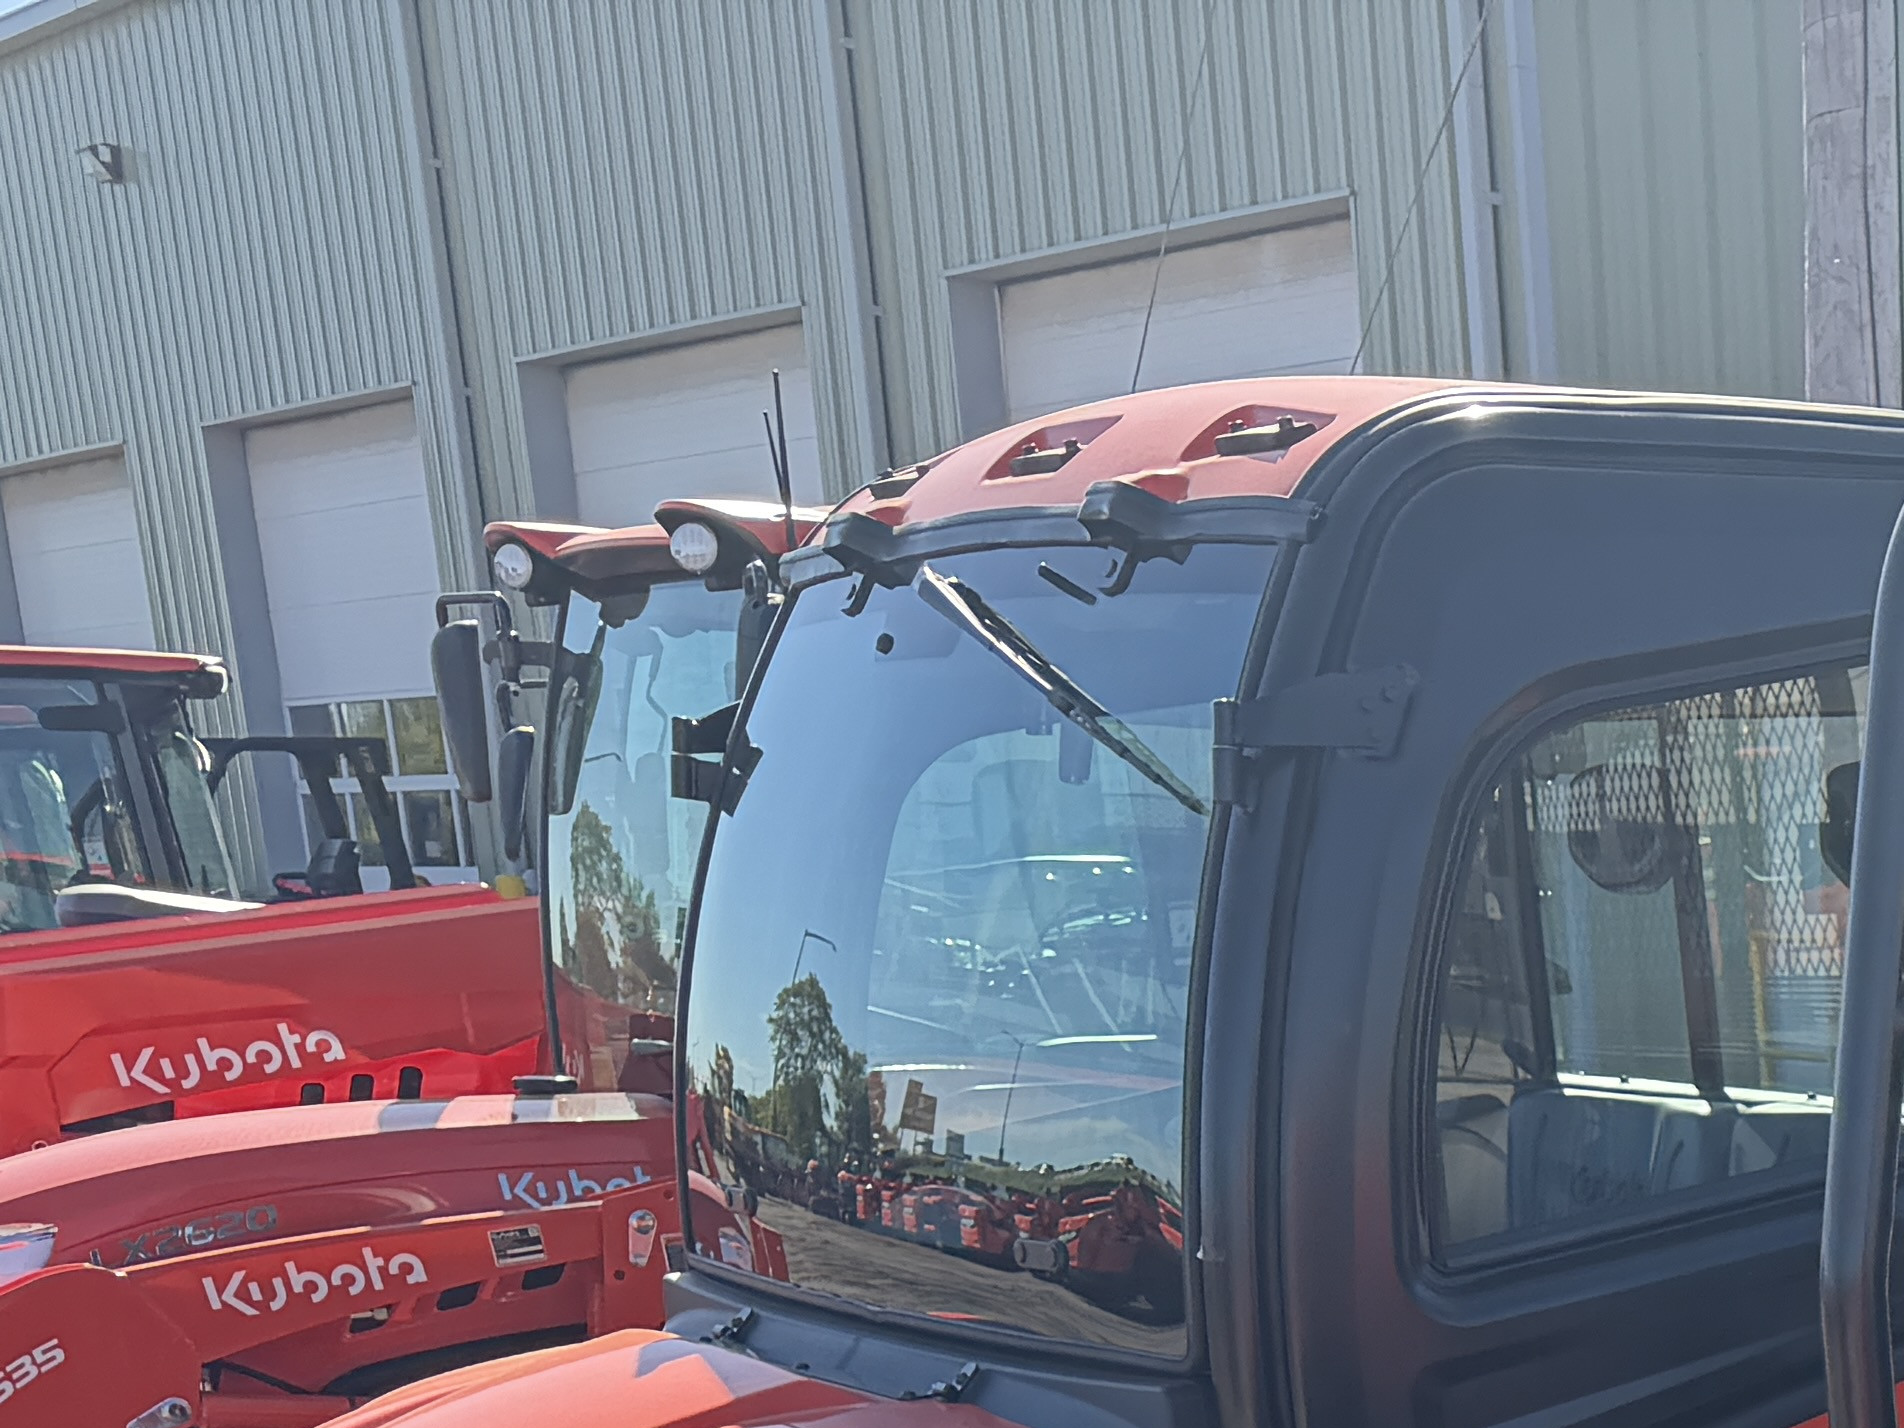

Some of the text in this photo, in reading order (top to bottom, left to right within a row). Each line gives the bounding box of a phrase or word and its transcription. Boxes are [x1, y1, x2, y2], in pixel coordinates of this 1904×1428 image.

[109, 1022, 347, 1094] Kubota
[497, 1164, 652, 1211] Kubot
[202, 1245, 429, 1316] Kubota
